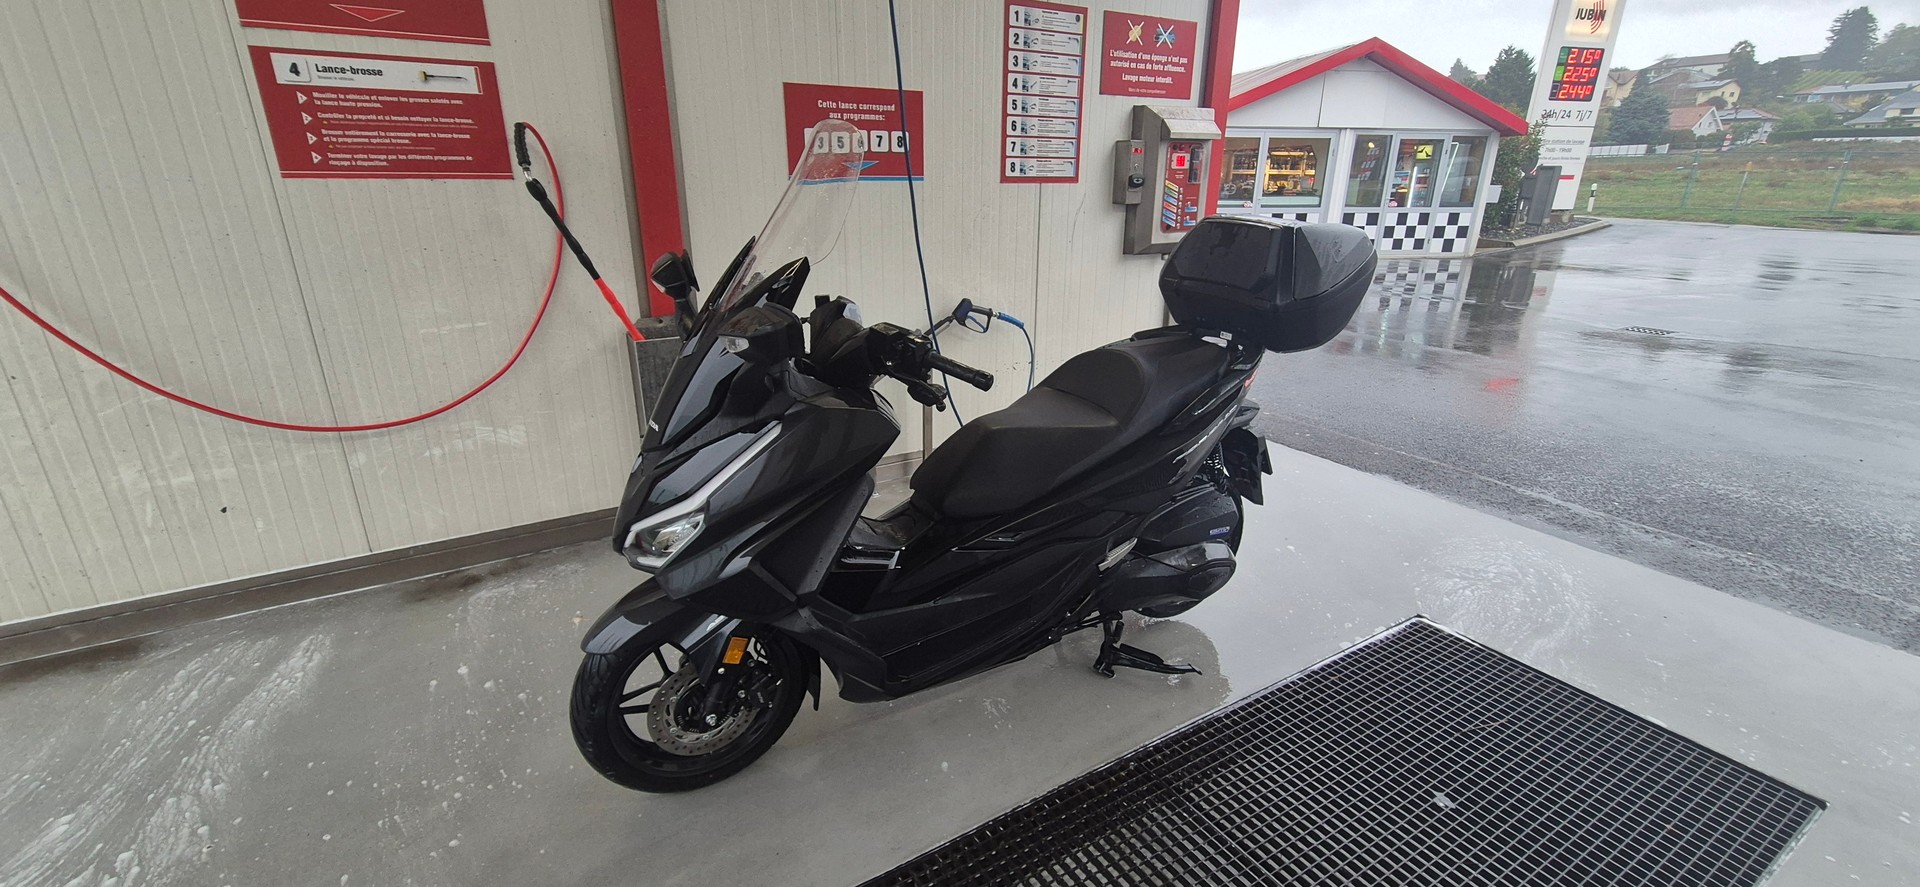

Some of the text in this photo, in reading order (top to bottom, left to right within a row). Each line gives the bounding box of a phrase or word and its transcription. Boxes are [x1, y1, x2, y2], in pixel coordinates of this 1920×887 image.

[1014, 9, 1019, 22] 1
[1575, 8, 1607, 21] JUBIN
[1013, 32, 1020, 45] 2
[1012, 55, 1019, 67] 3
[1110, 49, 1137, 59] L'utilisation
[1138, 52, 1151, 60] d'une
[1151, 53, 1167, 63] éponge
[289, 62, 383, 77] 4 Lance-brosse
[1110, 59, 1129, 68] autorisé
[1146, 62, 1152, 70] de
[1152, 63, 1163, 71] forte
[1164, 64, 1186, 73] affluence.
[1012, 77, 1018, 89] 4
[1122, 73, 1173, 84] Lavage moteur interdit.
[817, 99, 896, 112] Cette lance correspond
[1011, 99, 1018, 111] 5
[843, 112, 886, 121] programmes:
[1576, 110, 1593, 122] 7j/7
[1011, 120, 1017, 132] 6
[817, 136, 824, 149] 3
[837, 136, 845, 149] 5
[875, 135, 883, 147] 7
[896, 135, 904, 148] 8
[1010, 141, 1017, 153] 7
[1010, 161, 1016, 173] 8
